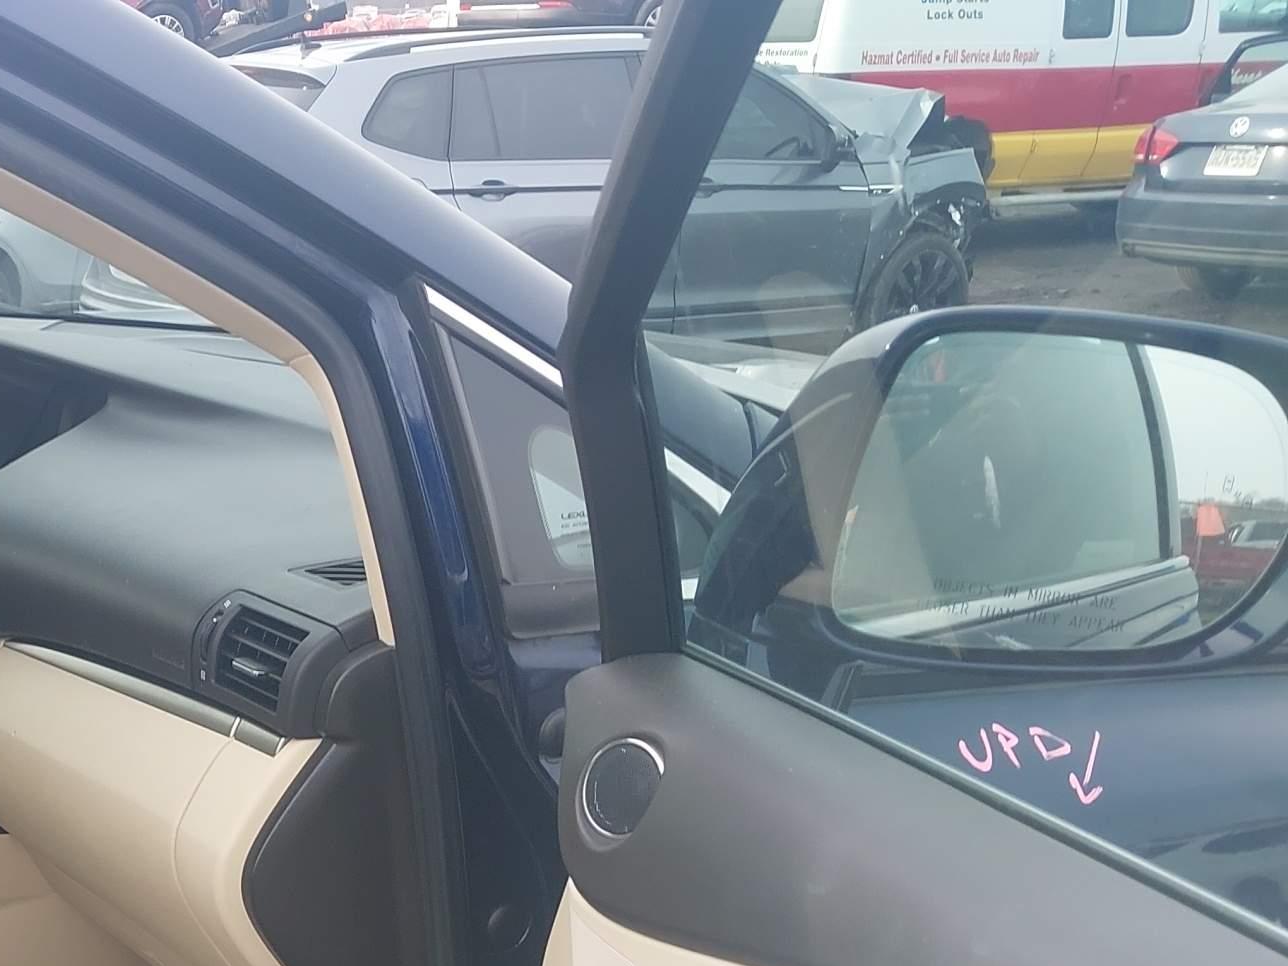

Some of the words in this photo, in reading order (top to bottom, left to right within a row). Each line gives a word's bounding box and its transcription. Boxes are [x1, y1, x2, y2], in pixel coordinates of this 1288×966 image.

[927, 9, 953, 20] Lock
[958, 9, 983, 19] Outs
[861, 49, 893, 65] Hazmat
[896, 49, 933, 65] Certified
[943, 49, 959, 63] Full
[960, 49, 990, 63] Service
[992, 49, 1011, 63] Auto
[1013, 48, 1040, 65] Repair
